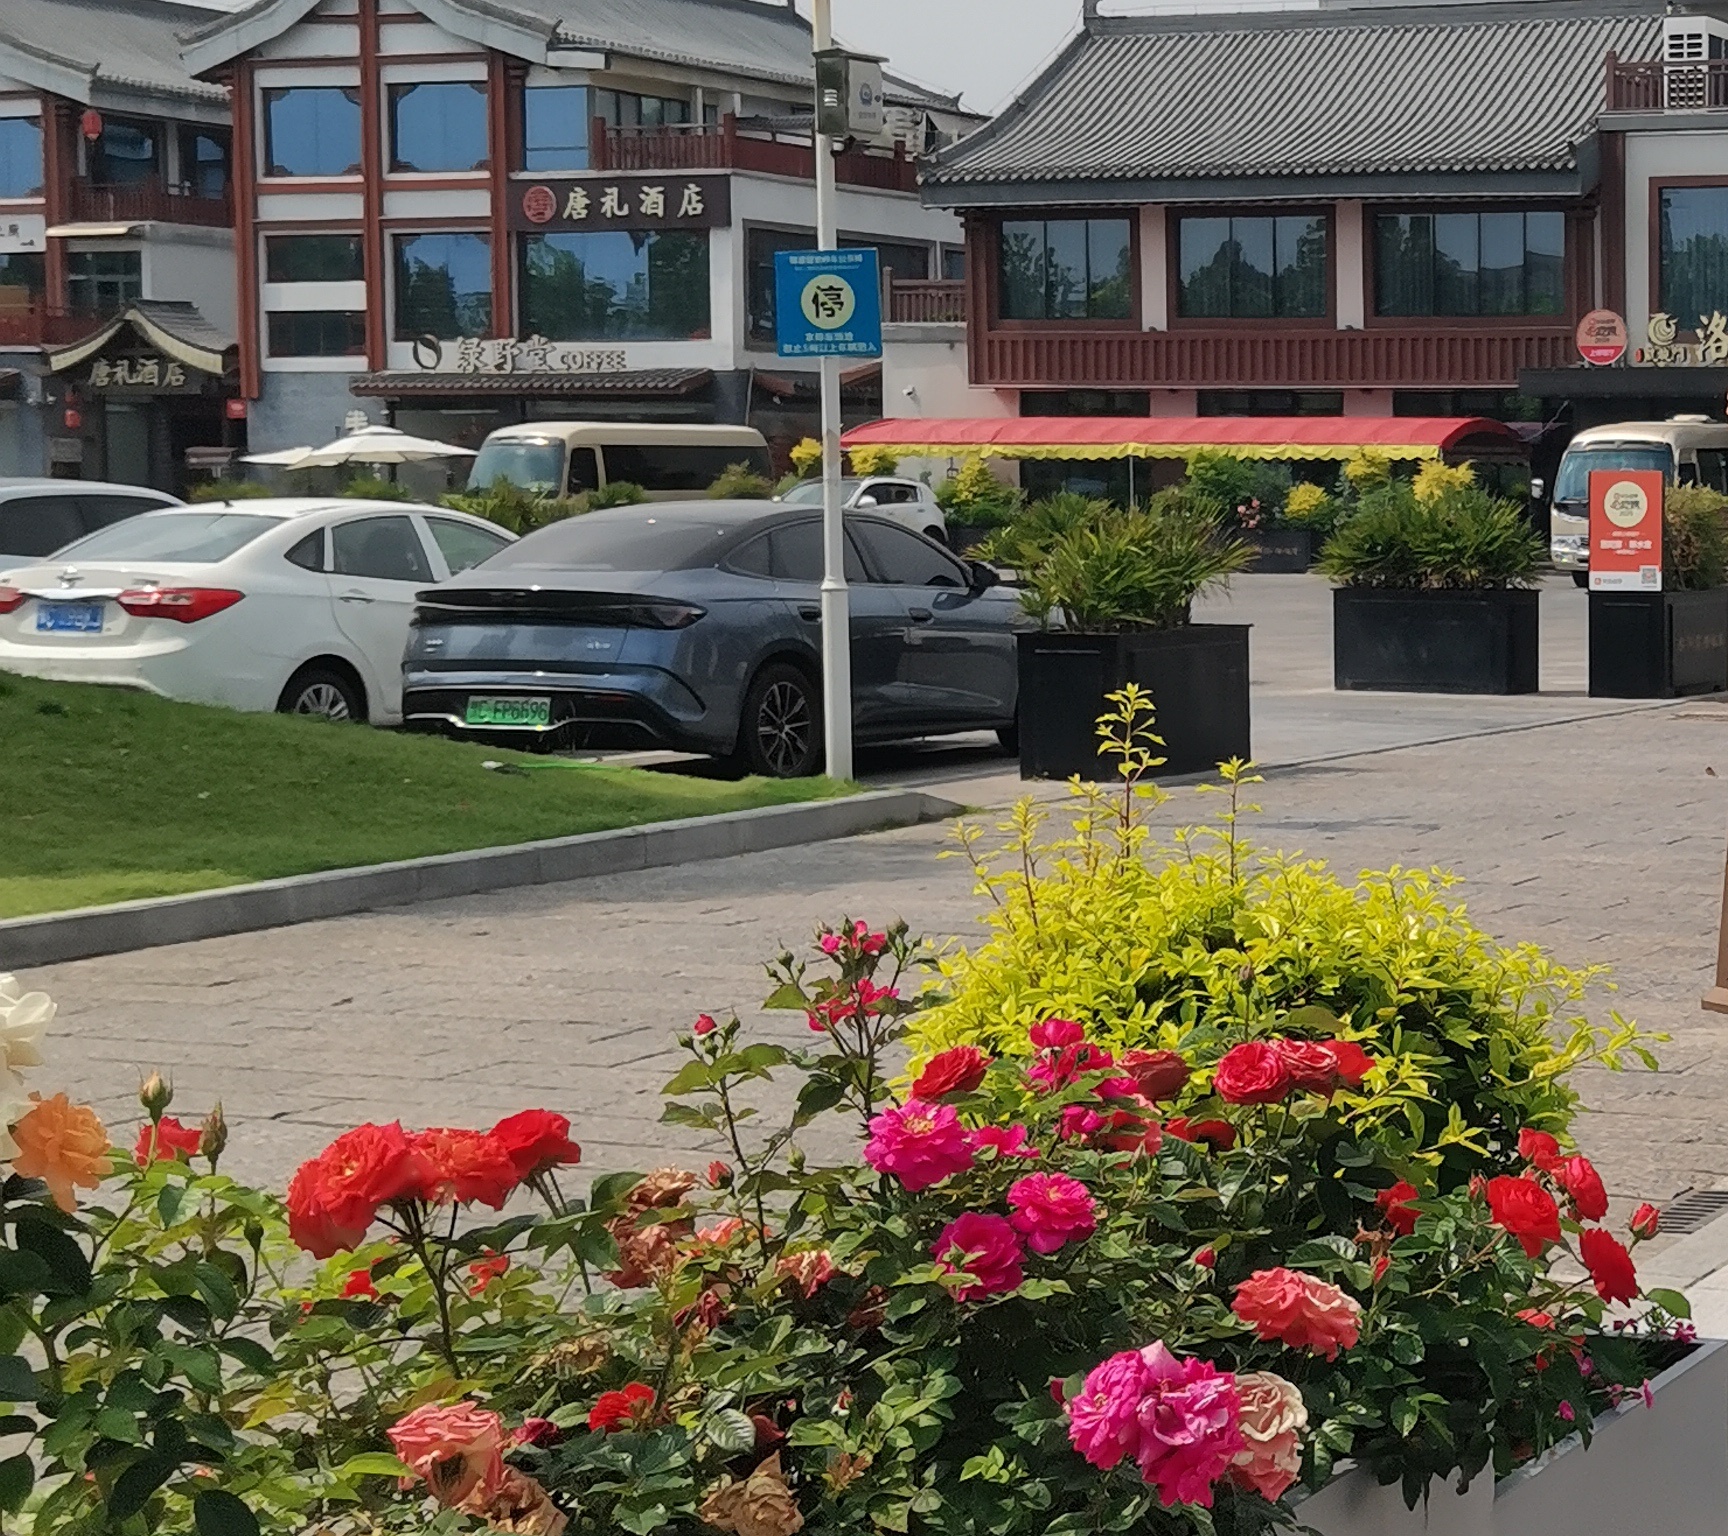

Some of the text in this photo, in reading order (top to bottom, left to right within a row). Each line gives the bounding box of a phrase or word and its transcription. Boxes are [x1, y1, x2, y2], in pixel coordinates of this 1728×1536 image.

[562, 183, 705, 220] 唐礼酒店
[812, 285, 844, 318] 停
[87, 357, 186, 387] 唐礼酒店
[560, 350, 627, 370] COFFEE
